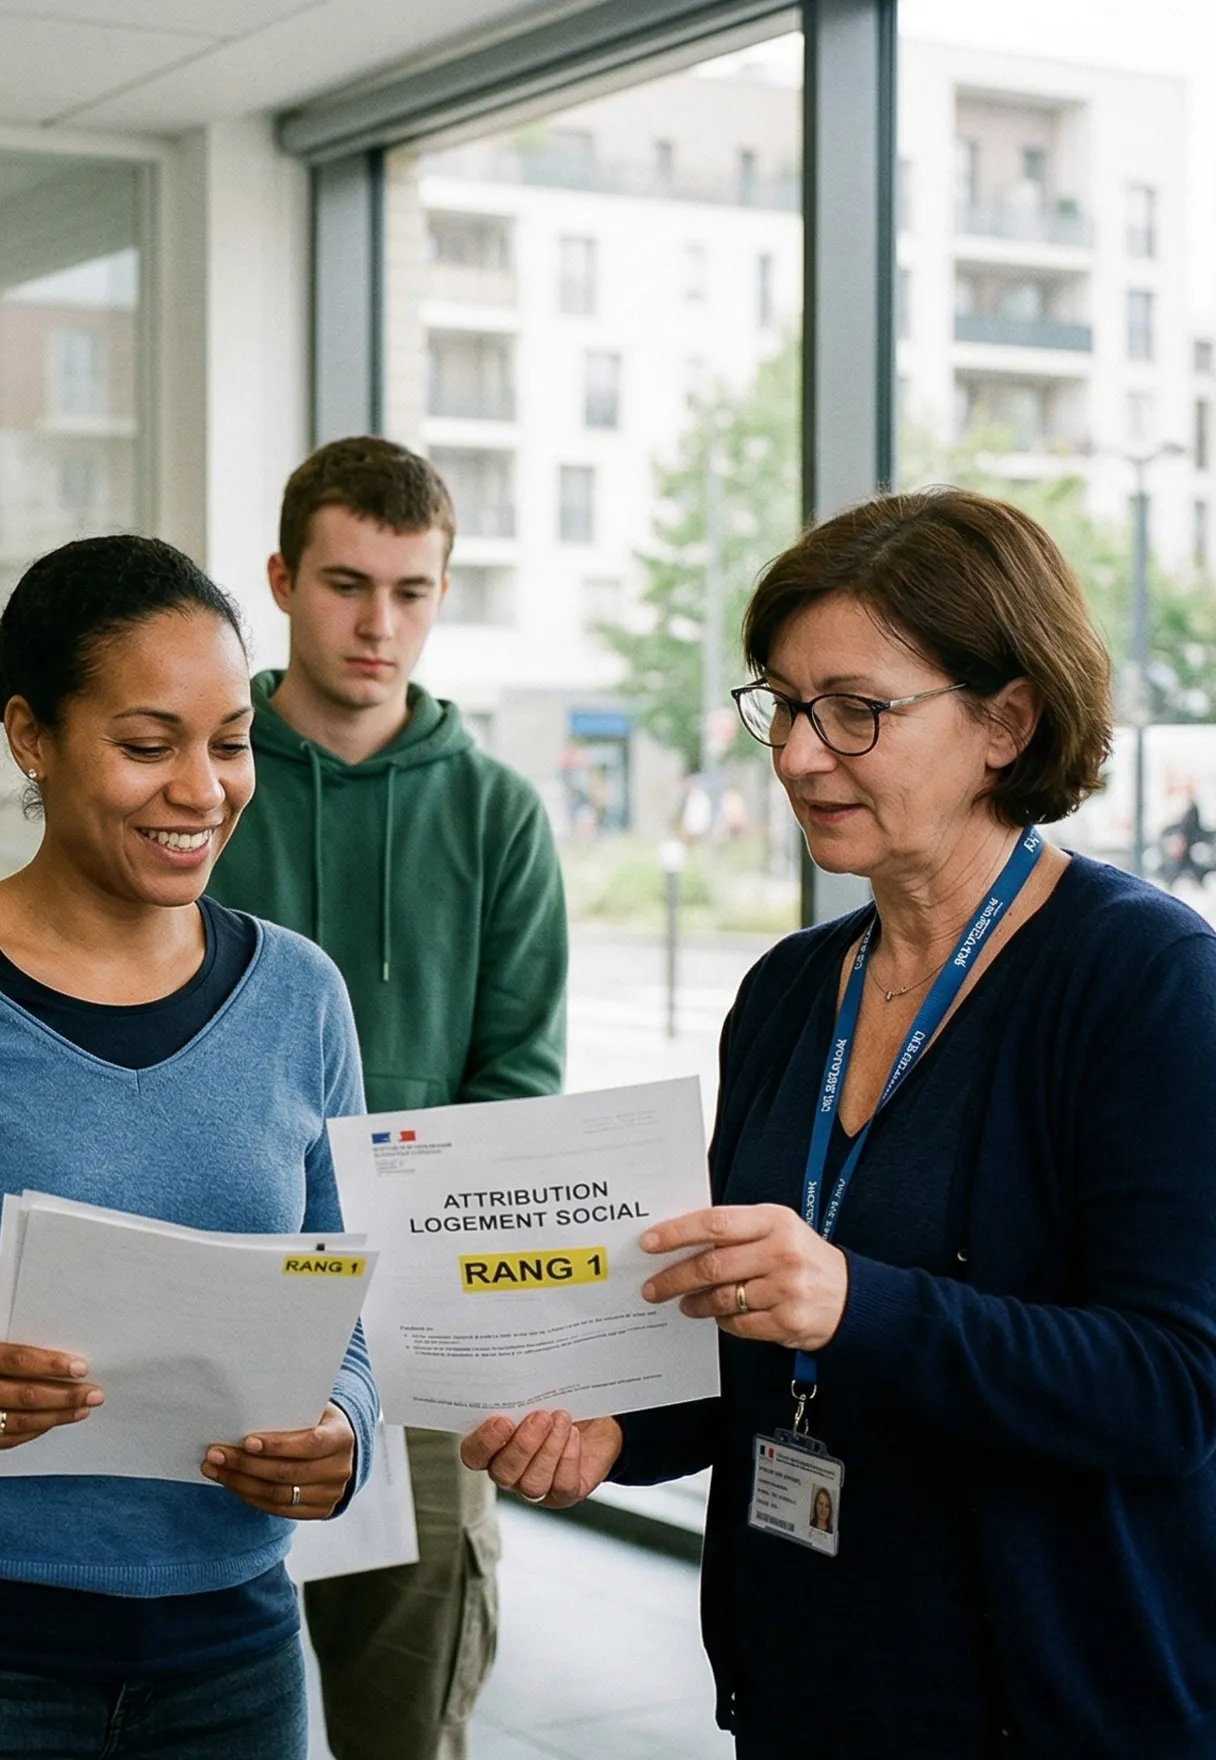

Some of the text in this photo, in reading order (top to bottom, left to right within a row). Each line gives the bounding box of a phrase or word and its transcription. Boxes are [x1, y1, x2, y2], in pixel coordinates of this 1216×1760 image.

[443, 1180, 609, 1209] ATTRIBUTION
[410, 1201, 650, 1234] LOGEMENT SOCIAL
[285, 1260, 359, 1275] RANG 1
[464, 1254, 602, 1285] RANG 1
